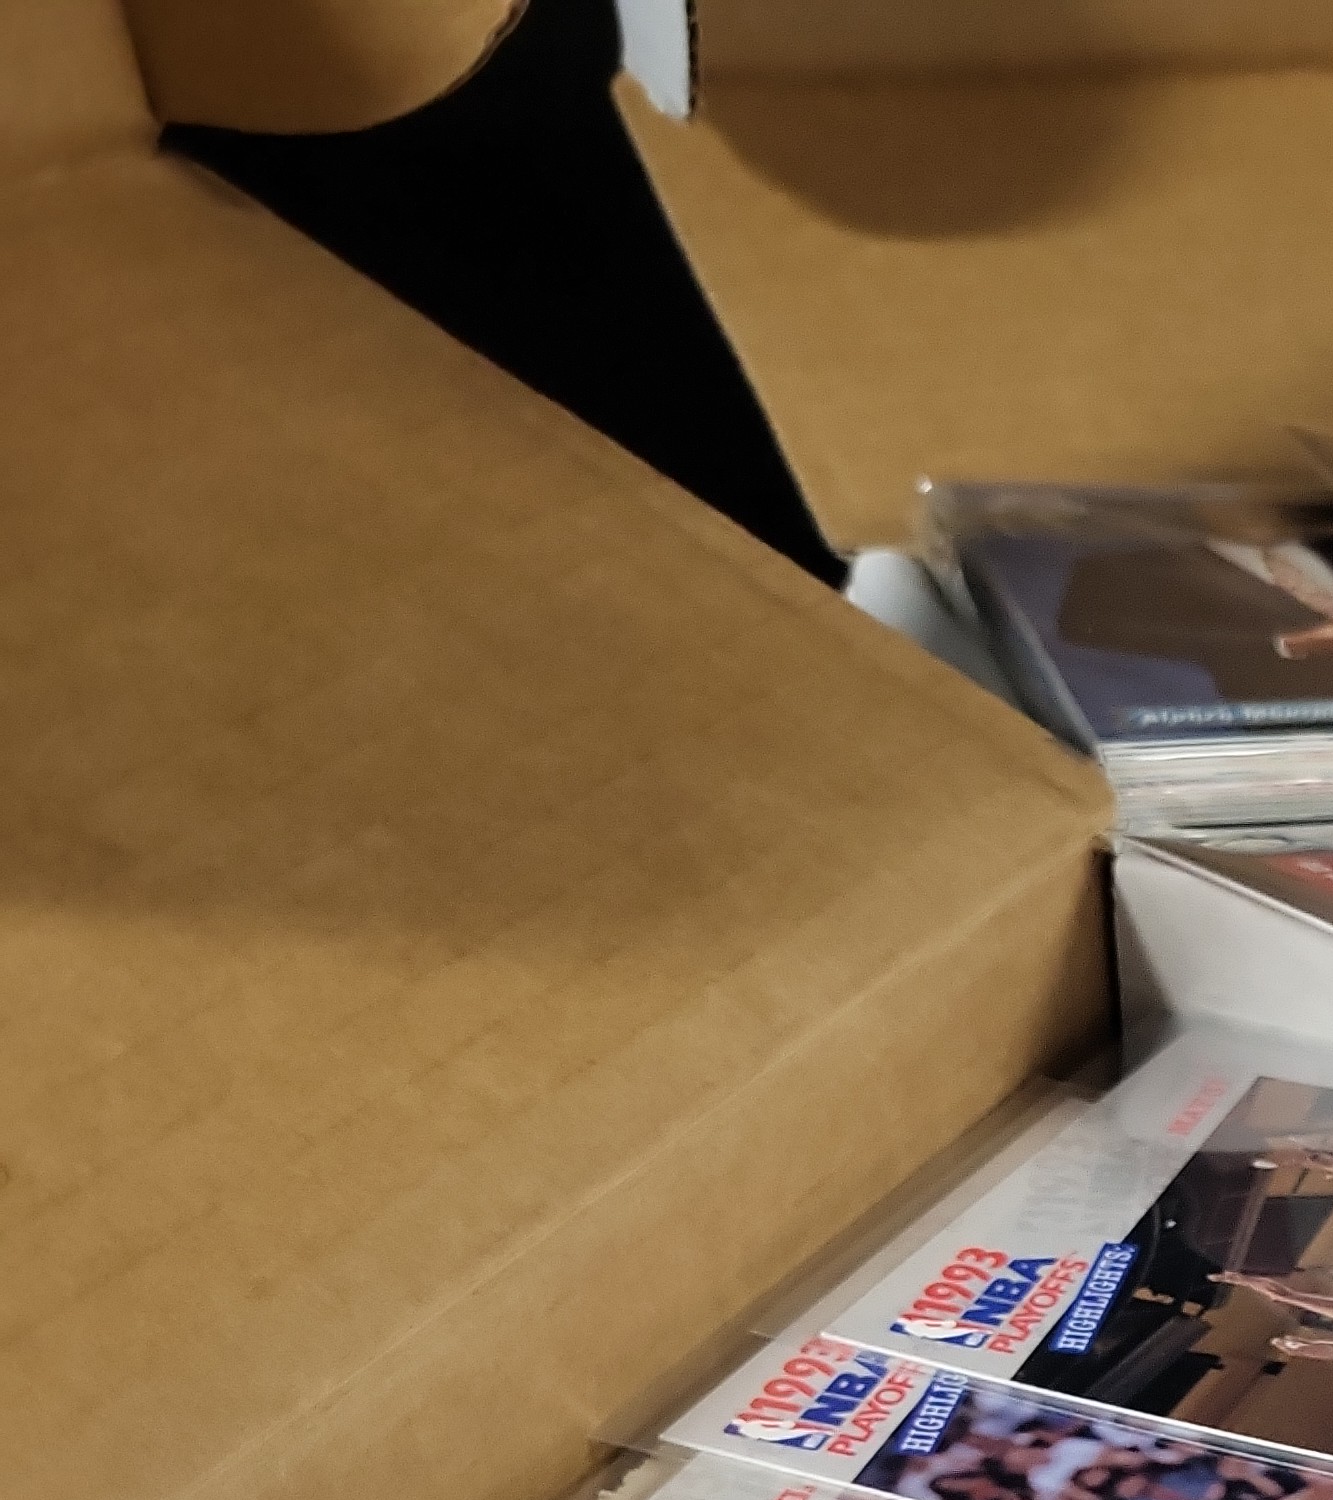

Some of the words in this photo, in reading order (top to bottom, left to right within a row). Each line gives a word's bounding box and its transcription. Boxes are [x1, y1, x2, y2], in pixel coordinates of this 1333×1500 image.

[914, 1246, 1010, 1315] 1993
[961, 1257, 1060, 1330] NBA
[987, 1258, 1090, 1355] PLAYOFFS
[1056, 1245, 1137, 1353] HIGHLIGHTS:
